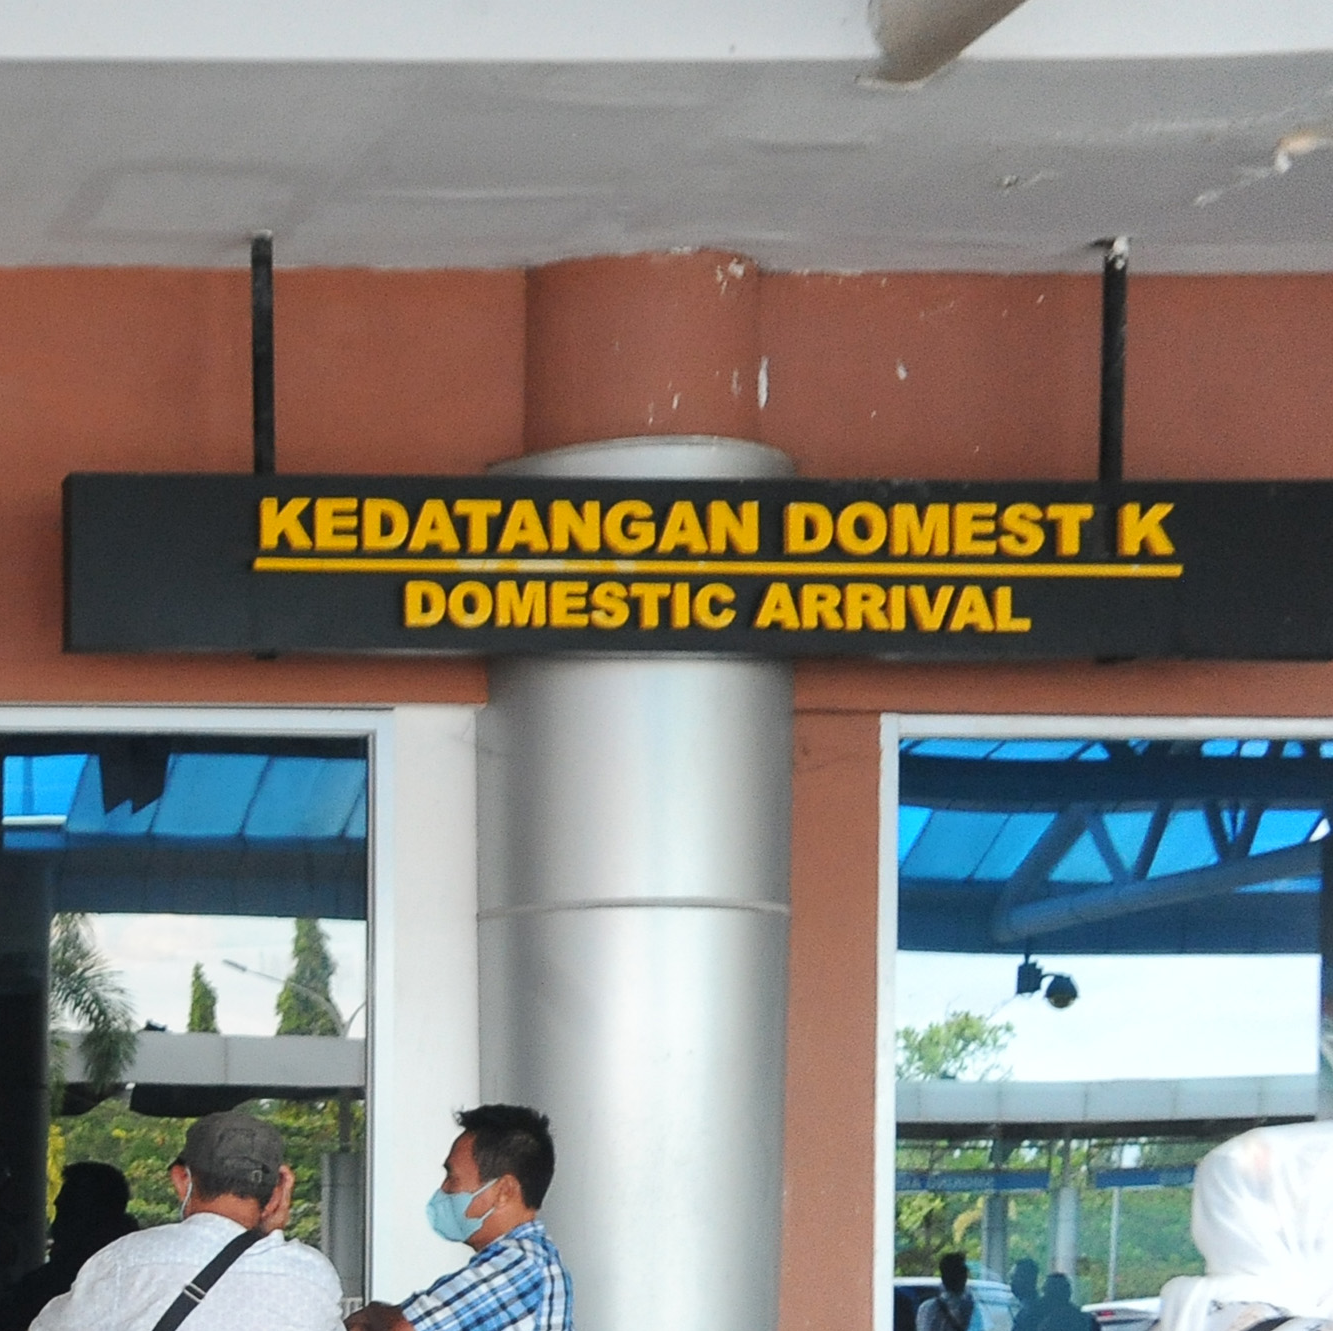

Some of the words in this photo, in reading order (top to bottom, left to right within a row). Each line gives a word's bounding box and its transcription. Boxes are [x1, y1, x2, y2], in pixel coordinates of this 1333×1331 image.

[258, 497, 759, 555] KEDATANGAN
[403, 579, 736, 630] DOMESTIC
[754, 583, 1032, 632] ARRIVAL
